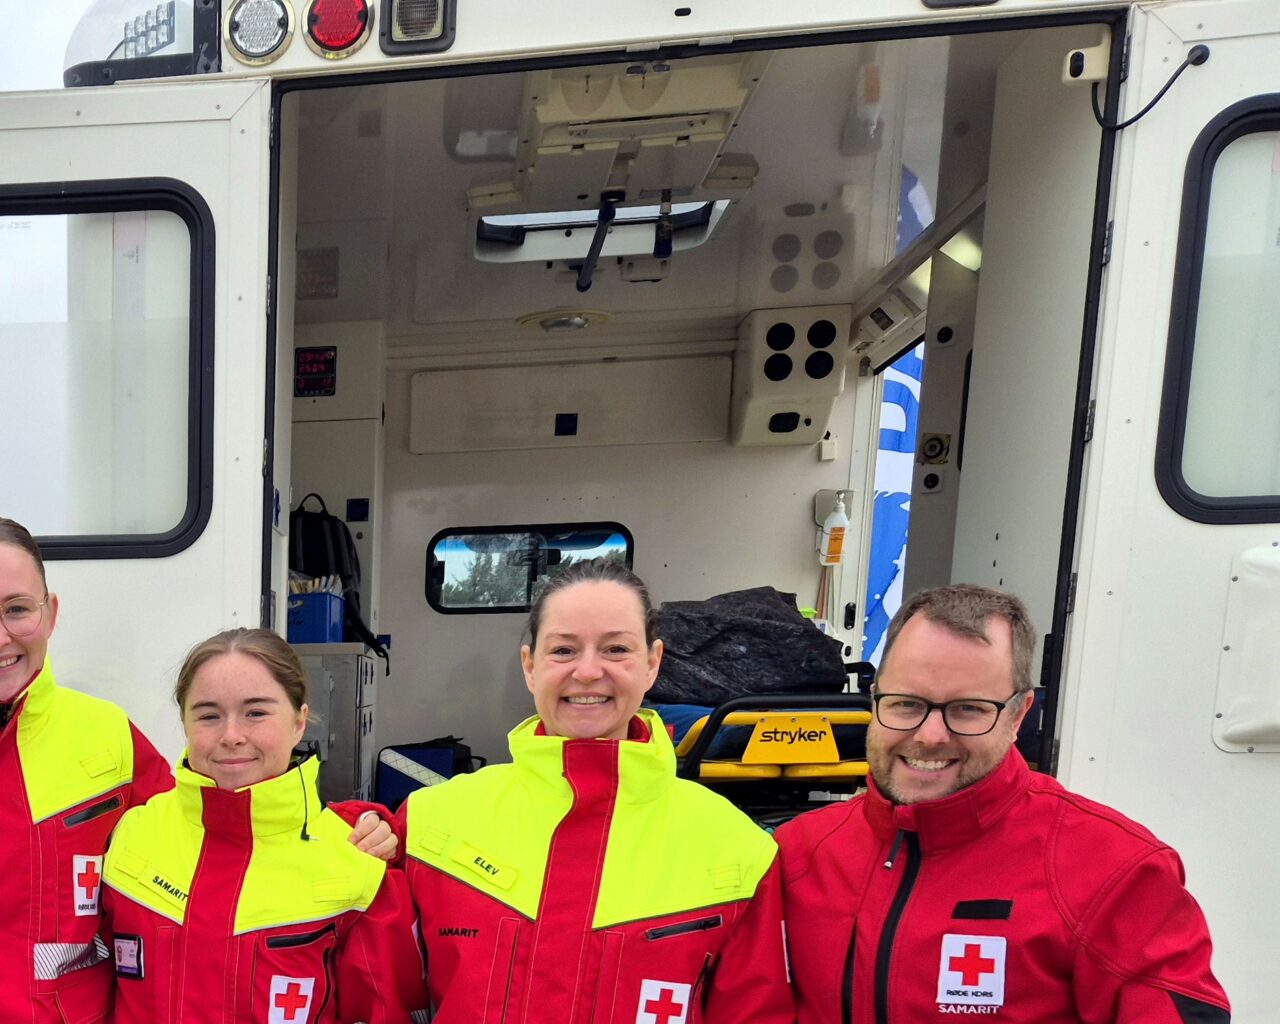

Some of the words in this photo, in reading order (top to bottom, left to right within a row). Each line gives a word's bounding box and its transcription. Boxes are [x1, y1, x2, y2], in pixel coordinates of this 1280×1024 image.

[759, 727, 827, 745] stryker
[474, 856, 500, 876] ELEV
[152, 875, 189, 902] SAMARIT
[438, 927, 480, 938] SAMARIT
[971, 990, 994, 998] KORS
[938, 1004, 1000, 1015] SAMARIT
